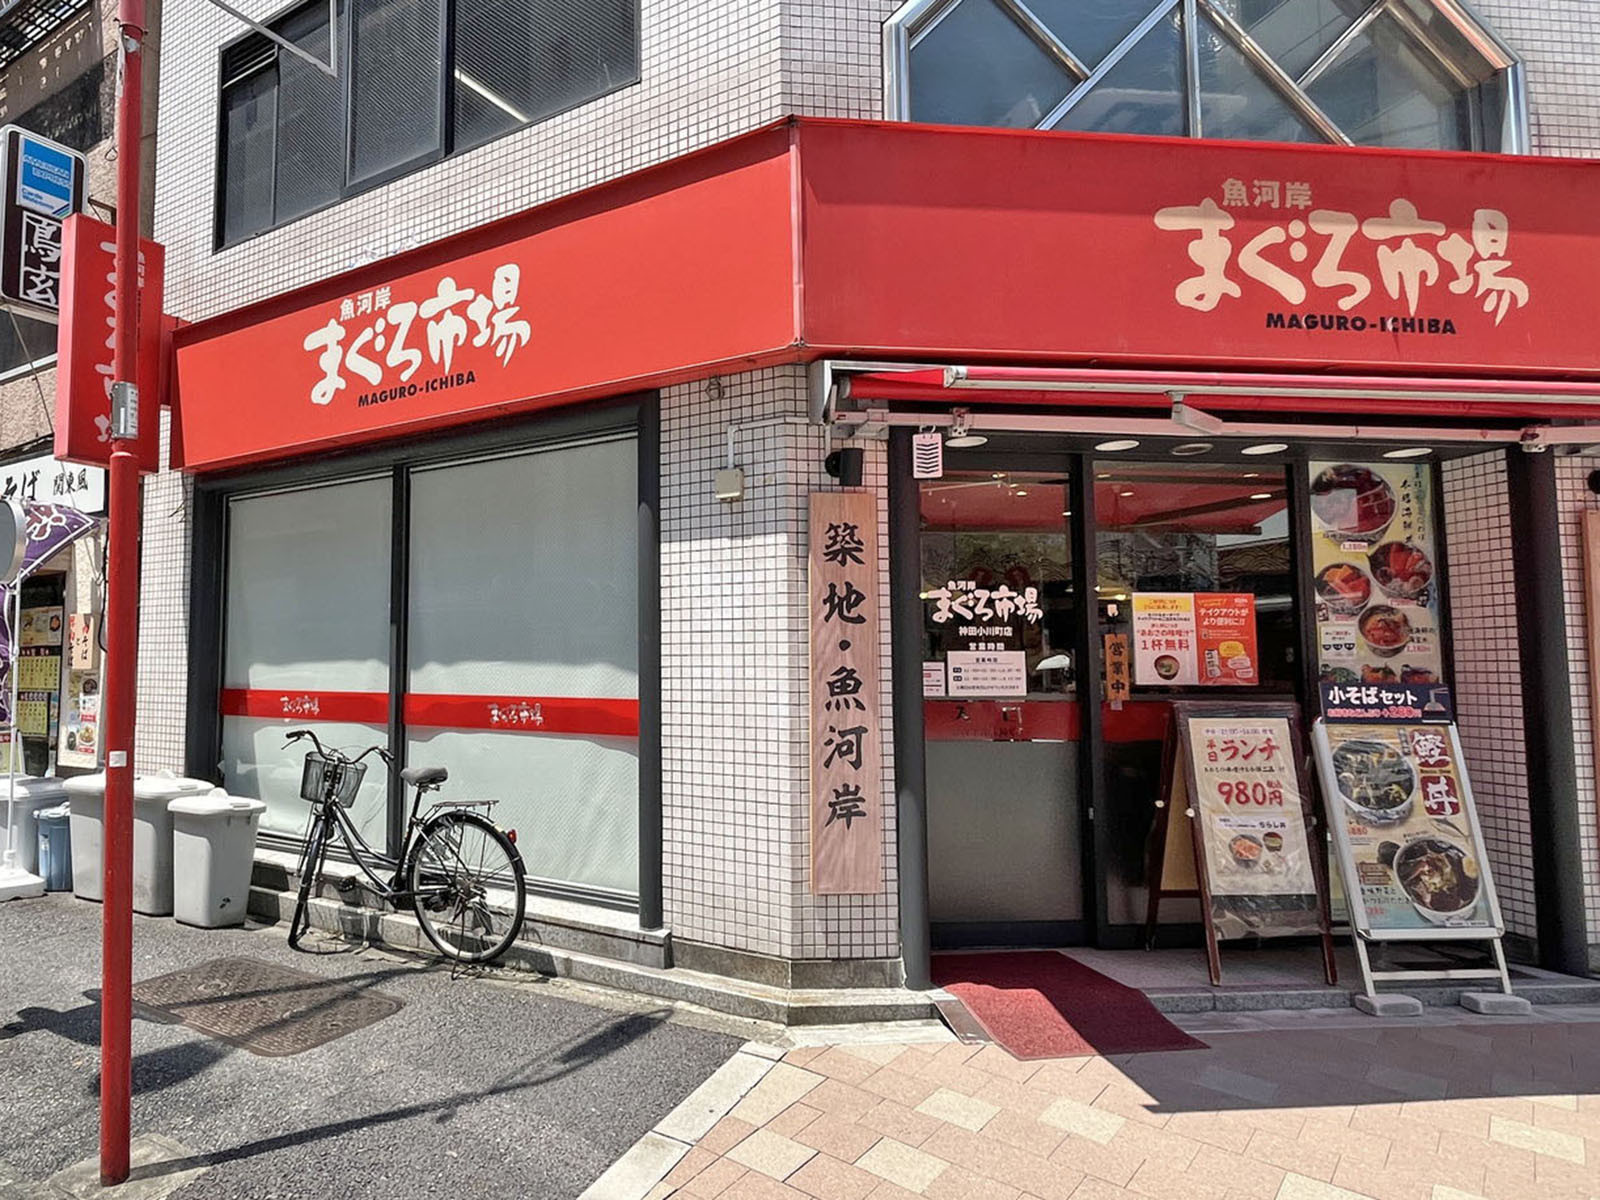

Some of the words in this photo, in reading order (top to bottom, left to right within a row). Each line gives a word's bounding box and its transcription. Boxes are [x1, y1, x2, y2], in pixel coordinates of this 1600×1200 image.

[1221, 178, 1313, 209] 魚河岸
[1154, 197, 1529, 327] まぐろ市場
[339, 286, 392, 322] 魚河岸
[303, 263, 531, 405] まぐろ市場
[1265, 313, 1457, 334] MAGURO-ICHIBA
[358, 370, 475, 408] MAGURO-ICHIBA
[925, 584, 1043, 624] まぐろ市場
[822, 522, 867, 829] 築地・魚河岸
[1109, 642, 1126, 694] 営業中
[1328, 686, 1418, 705] 小そばセット
[488, 701, 543, 727] まぐろ市場
[1220, 737, 1281, 761] ランチ
[1217, 780, 1267, 806] 980
